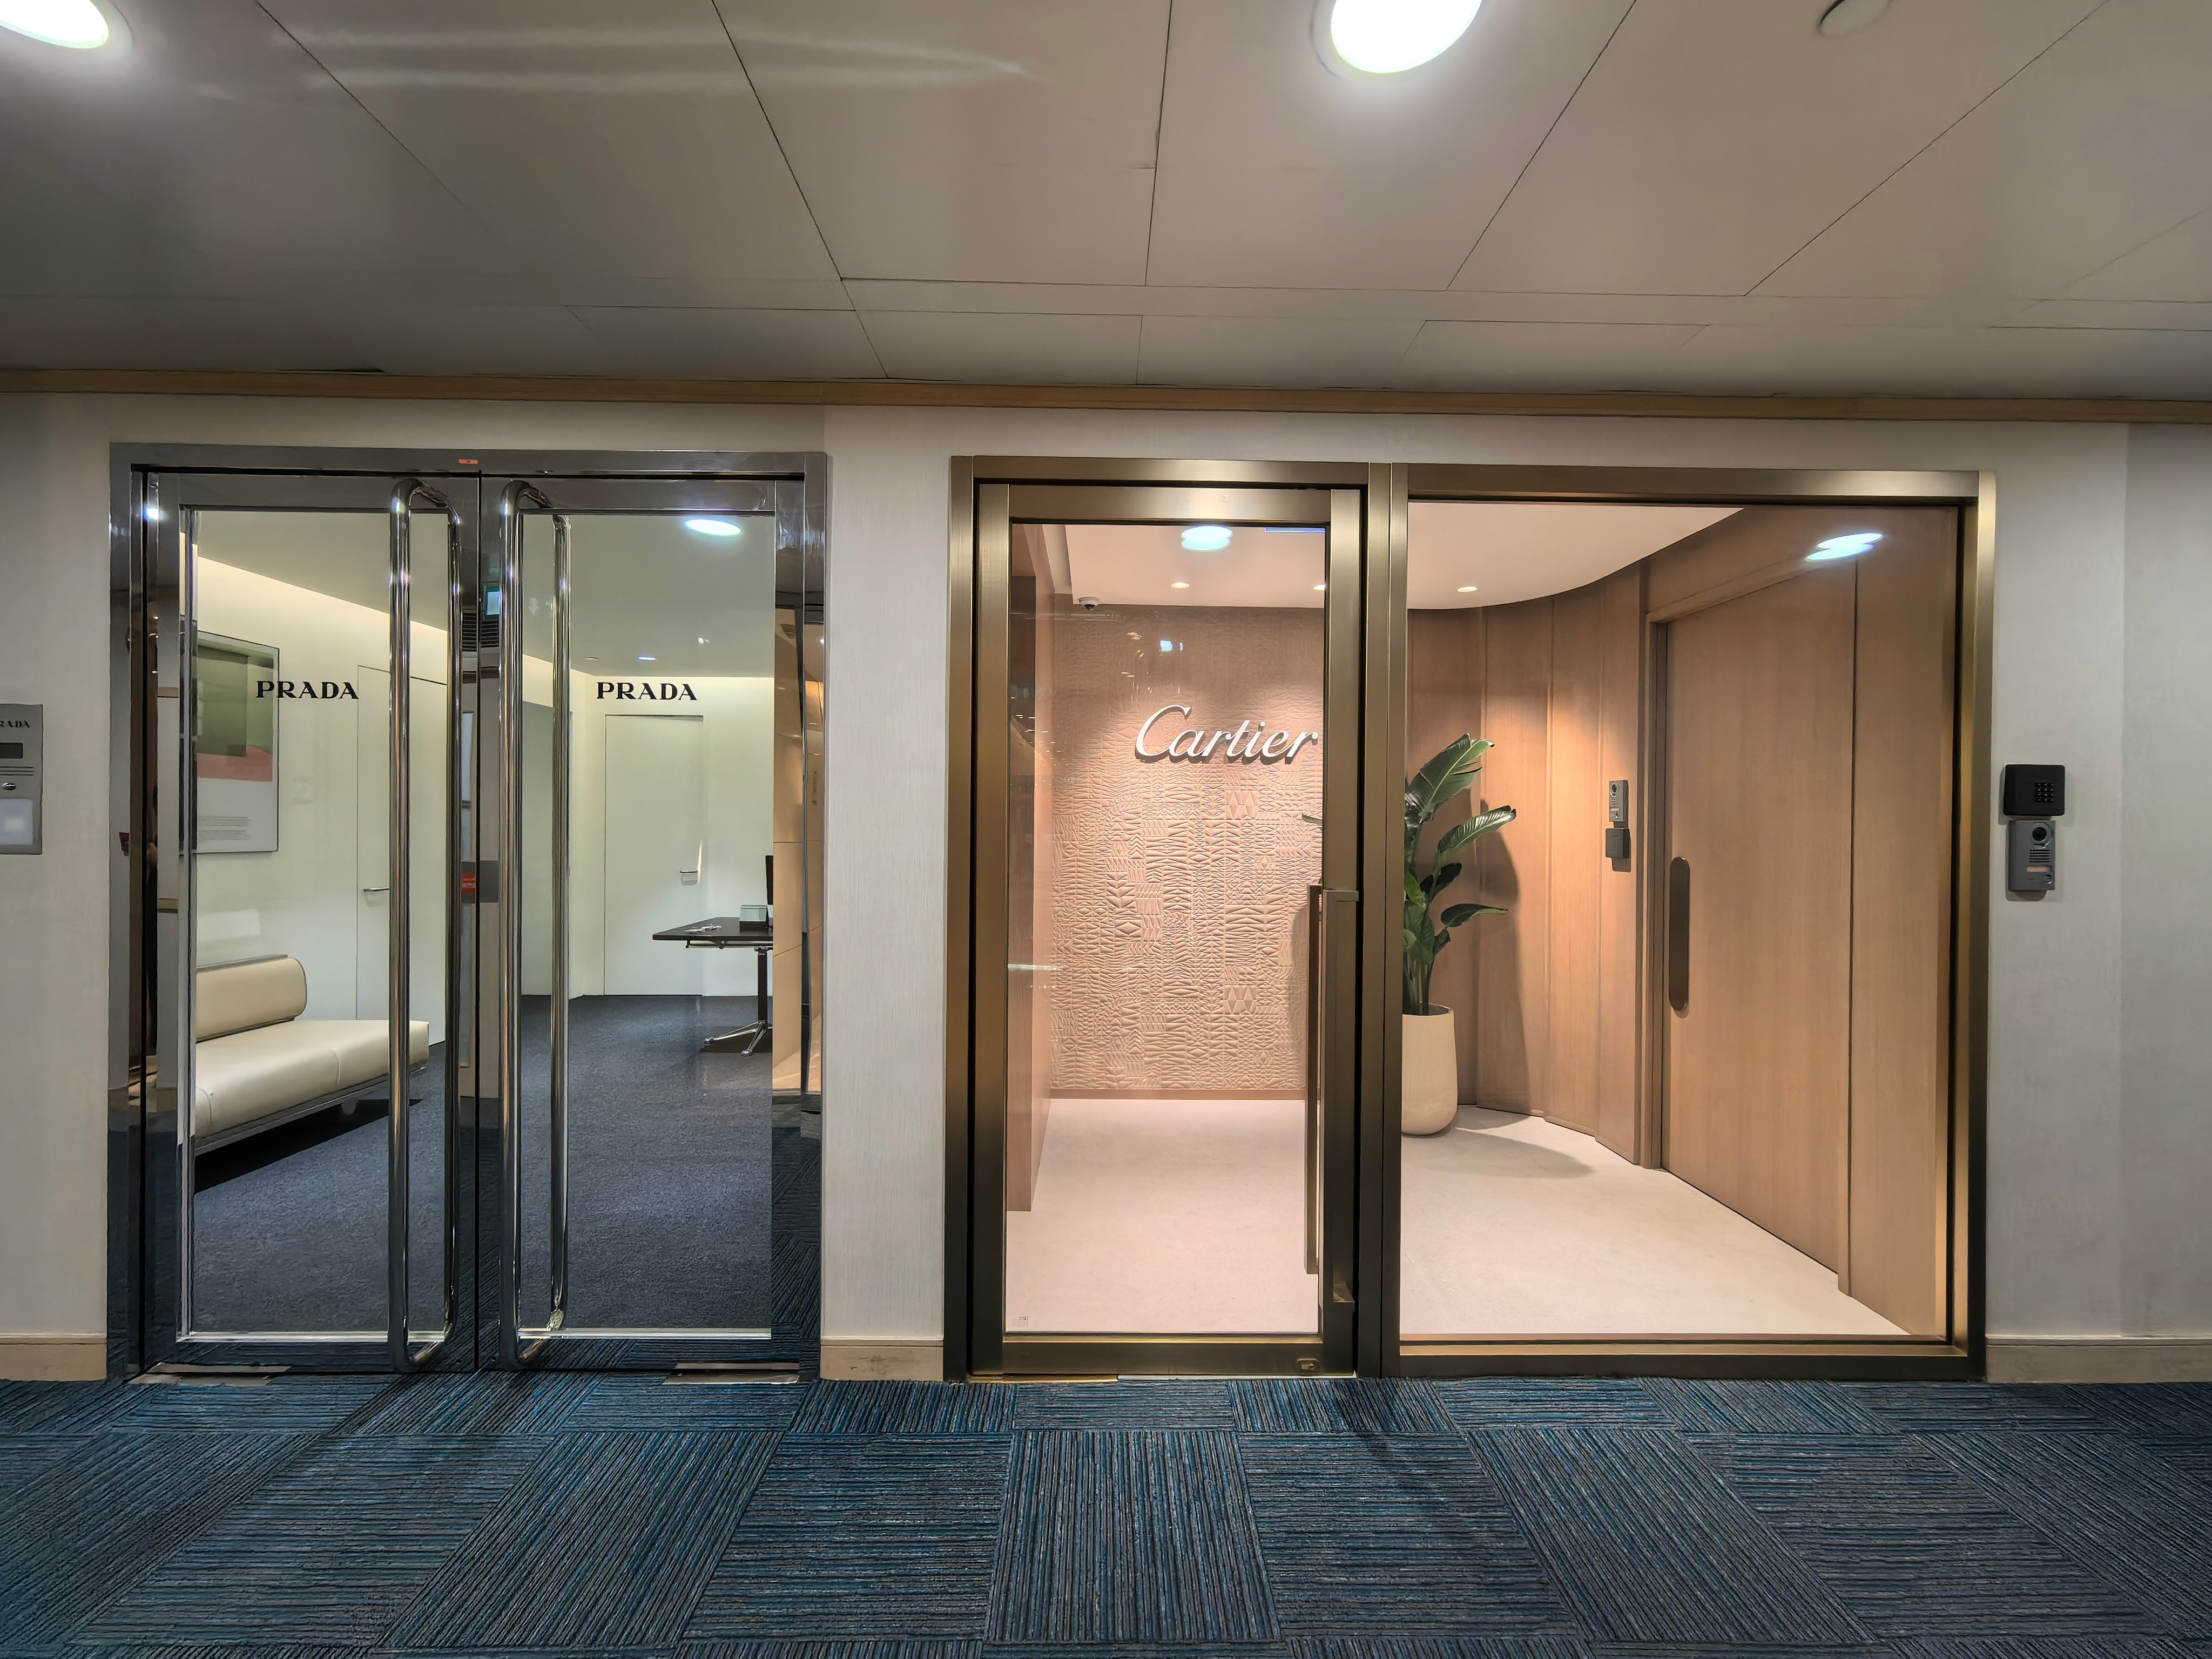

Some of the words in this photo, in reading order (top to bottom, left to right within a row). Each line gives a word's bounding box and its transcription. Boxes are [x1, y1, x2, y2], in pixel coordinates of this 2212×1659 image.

[256, 681, 359, 699] PRADA
[596, 682, 698, 700] PRADA
[1135, 704, 1319, 764] Cartier
